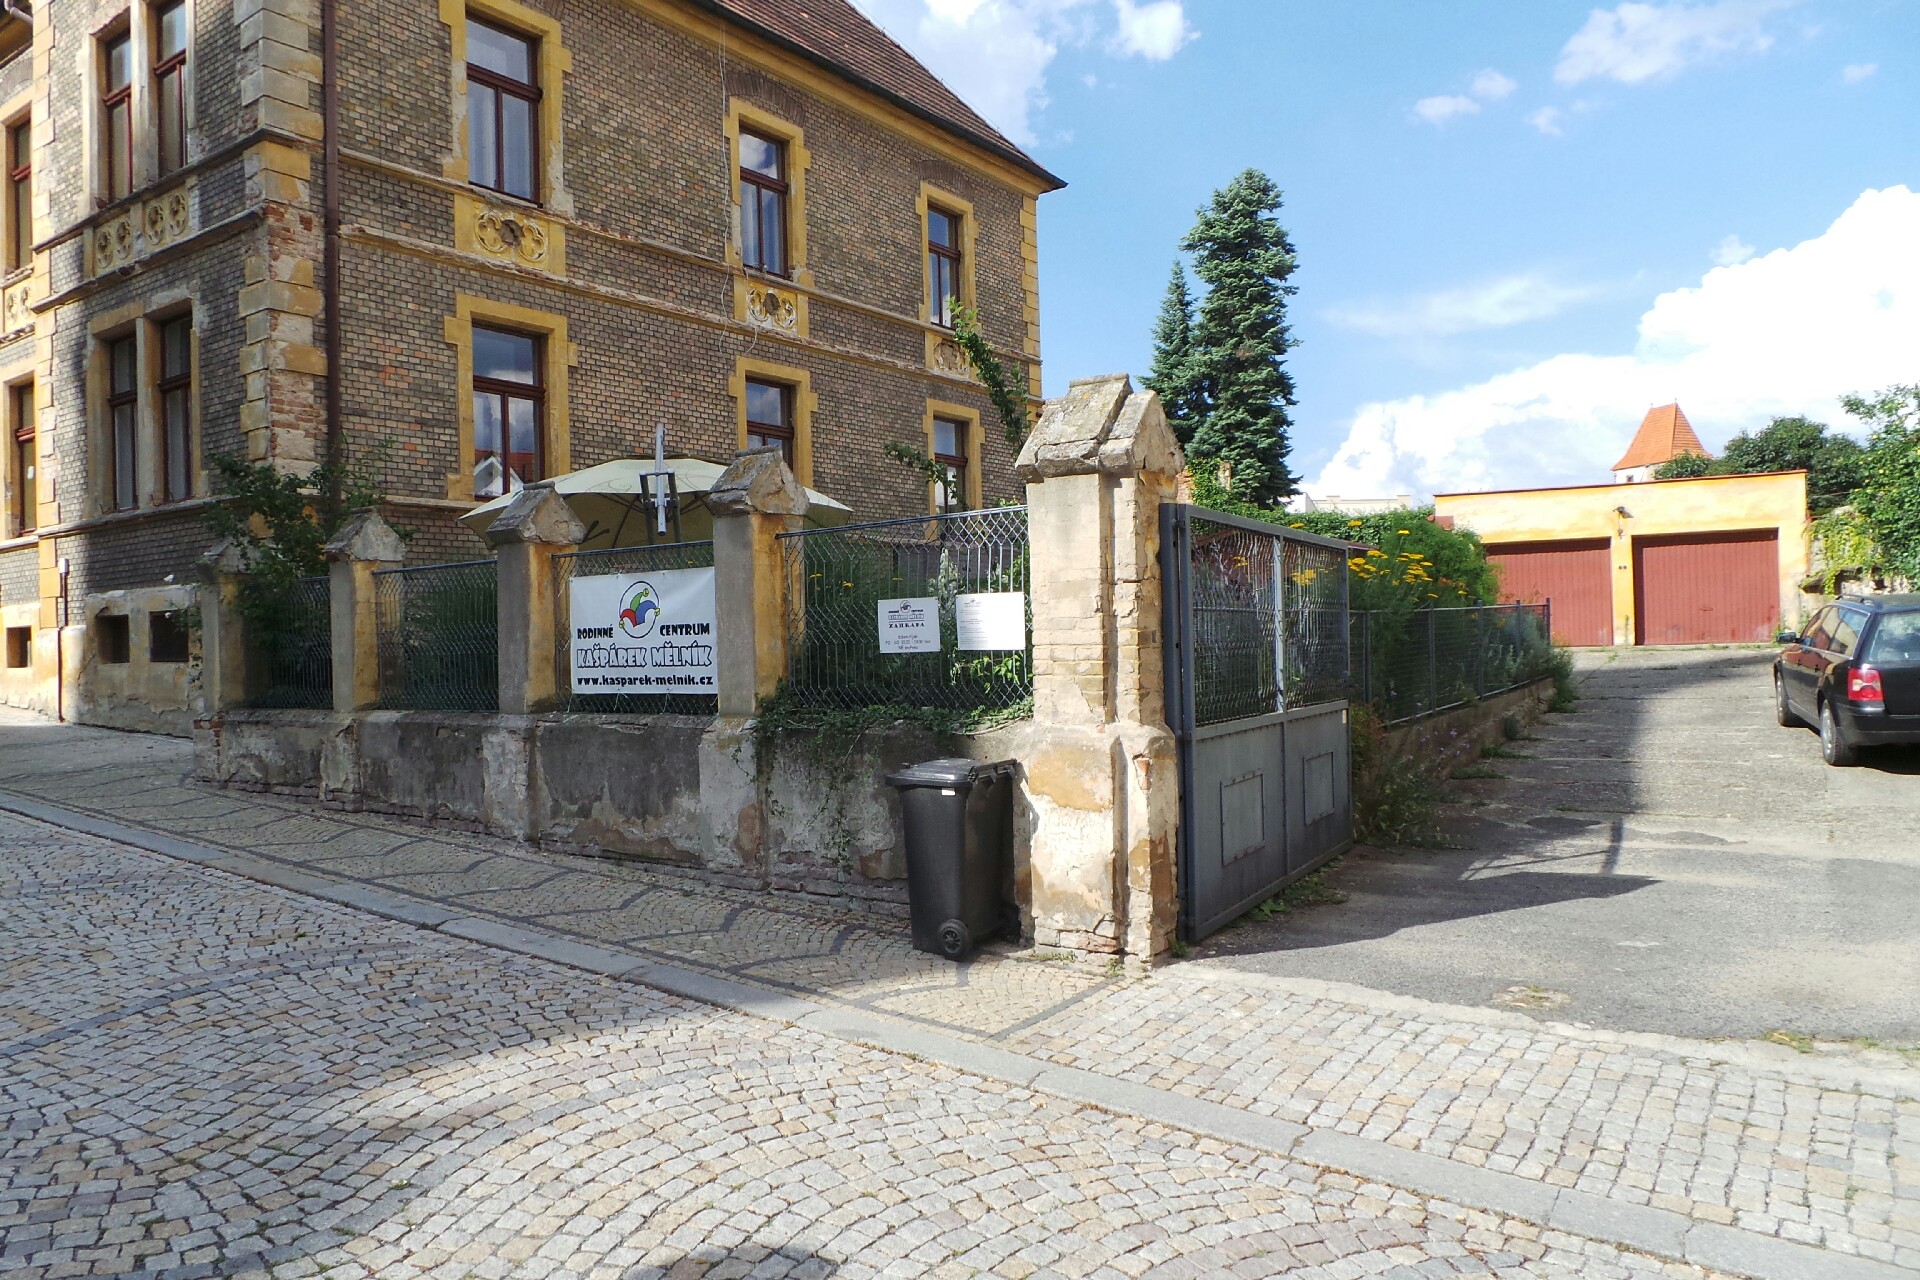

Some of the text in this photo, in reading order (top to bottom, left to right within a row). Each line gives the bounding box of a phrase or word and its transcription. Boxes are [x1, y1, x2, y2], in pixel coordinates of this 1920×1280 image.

[577, 623, 710, 639] RODINNÉ CENTRUM
[576, 640, 712, 668] KAŠPÁREK MĚLNÍK
[577, 674, 714, 687] www.kasparek-melnik.cz
